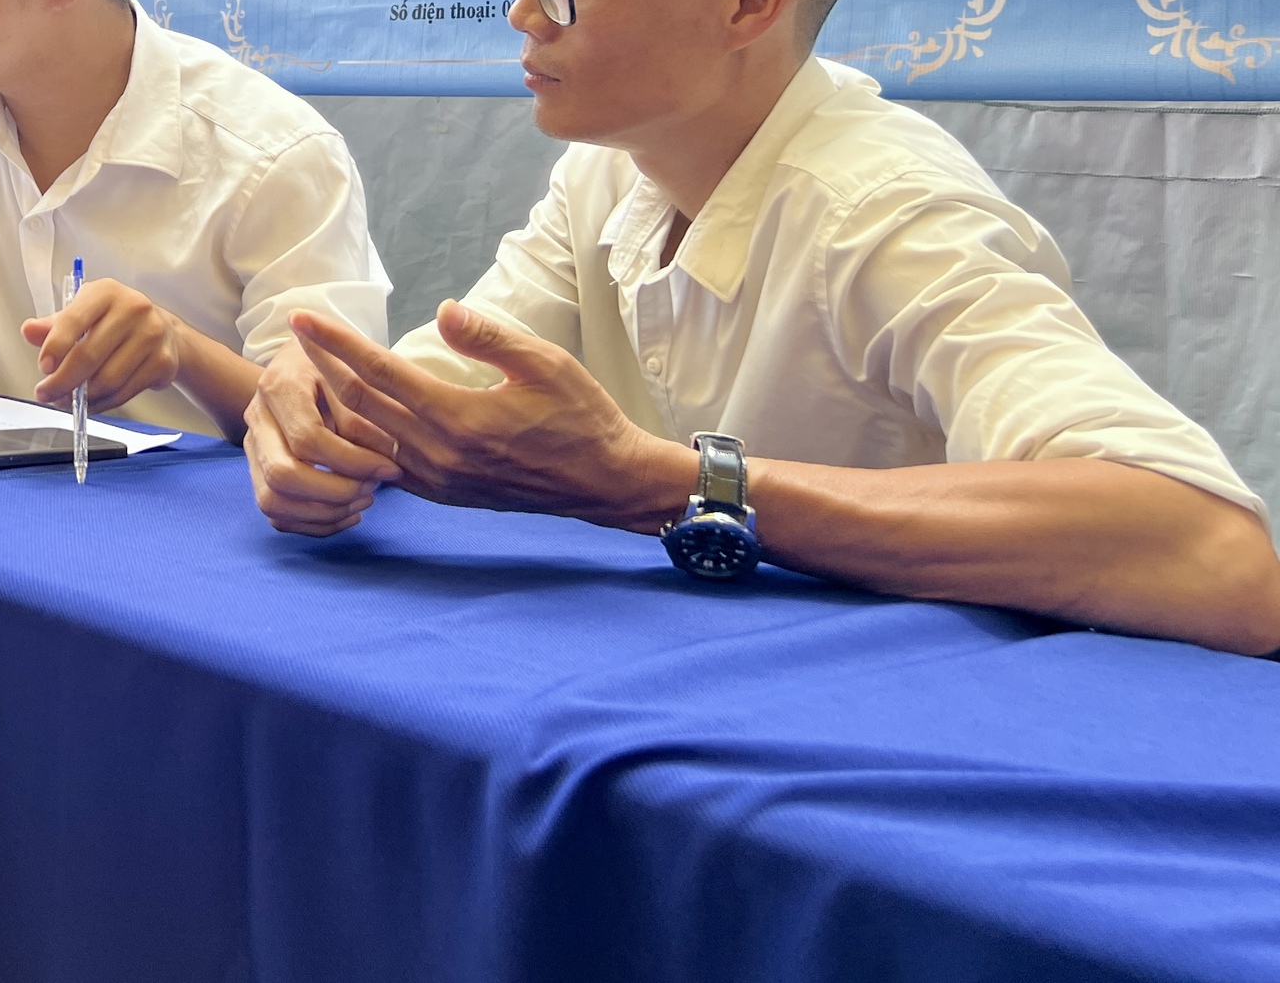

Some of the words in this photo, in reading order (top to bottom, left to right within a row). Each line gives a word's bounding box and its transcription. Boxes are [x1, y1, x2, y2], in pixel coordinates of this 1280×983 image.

[389, 0, 408, 21] Số
[412, 2, 445, 24] điện
[450, 0, 496, 22] thoại:
